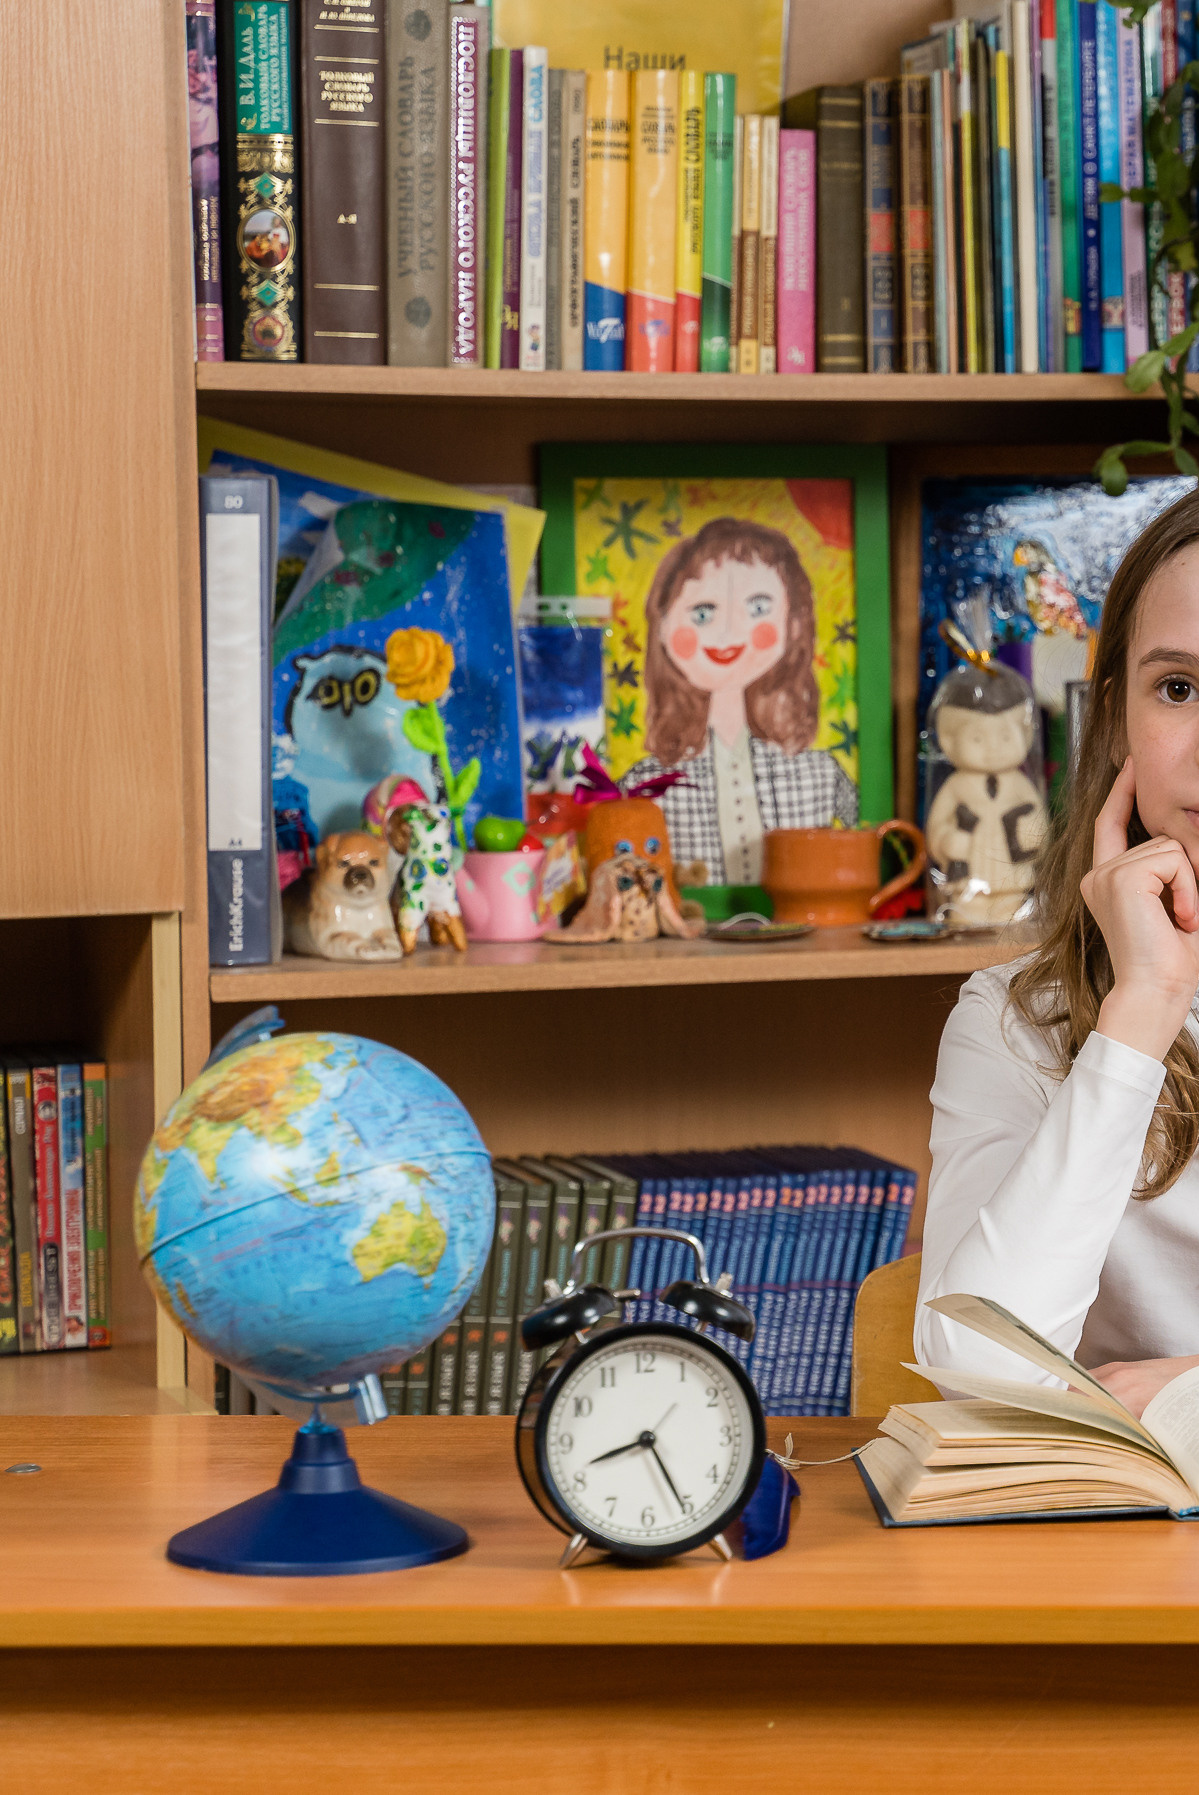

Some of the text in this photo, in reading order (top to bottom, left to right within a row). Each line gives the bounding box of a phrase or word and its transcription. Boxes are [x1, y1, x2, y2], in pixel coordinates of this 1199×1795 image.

[256, 4, 271, 130] ТОЛКОВЫЙ СЛОВАРЬ
[603, 46, 686, 71] Наши
[269, 57, 282, 123] РУССКОГО
[320, 90, 374, 103] РУССКОГО
[529, 65, 543, 123] СЛОВА
[396, 55, 416, 158] СЛОВАРЬ
[417, 65, 439, 272] РУССКОГО ЯЗЫКА
[456, 24, 477, 355] ПОСЛОВИЦЫ РУССКОГО НАРОДА
[224, 495, 243, 509] 80
[228, 857, 244, 952] ErichKrause
[635, 1353, 656, 1374] 12
[678, 1361, 687, 1382] 1
[599, 1367, 617, 1388] 11
[573, 1396, 593, 1418] 10
[705, 1387, 720, 1408] 2
[558, 1433, 573, 1454] 9
[719, 1426, 733, 1447] 3
[573, 1471, 587, 1492] 8
[705, 1463, 720, 1484] 4
[604, 1496, 617, 1517] 7
[682, 1494, 694, 1514] 5
[640, 1507, 655, 1528] 6
